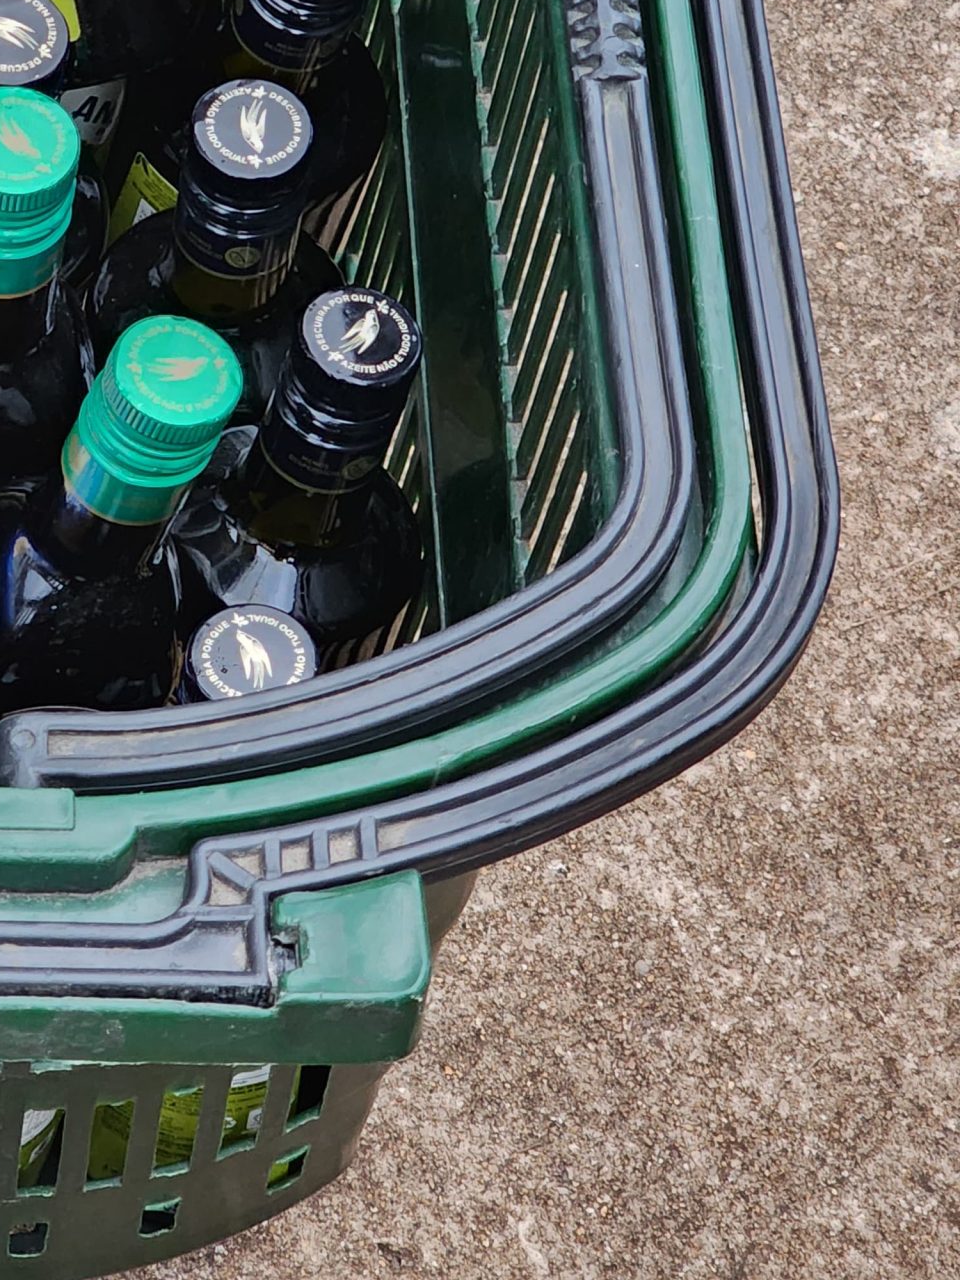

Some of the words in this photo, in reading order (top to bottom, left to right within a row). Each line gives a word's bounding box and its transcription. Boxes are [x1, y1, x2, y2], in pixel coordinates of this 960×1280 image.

[32, 0, 51, 17] NÃO
[45, 17, 57, 47] AZEITE
[218, 87, 252, 103] AZEITE
[206, 101, 222, 117] NÃO
[268, 91, 302, 134] DESCUBRA
[205, 125, 222, 149] TUDO
[284, 135, 301, 153] POR
[219, 146, 248, 165] IGUAL
[265, 151, 288, 165] QUE
[313, 305, 330, 351] DESCUBRA
[329, 294, 350, 307] POR
[351, 293, 375, 304] QUE
[389, 309, 409, 333] IGUAL
[400, 334, 411, 357] TUDO
[341, 360, 376, 374] AZEITE
[376, 359, 397, 372] NÃO
[210, 620, 230, 638] QUE
[246, 614, 280, 627] IGUAL
[278, 624, 301, 647] TUDO
[201, 638, 215, 659] POR
[294, 655, 306, 676] NÃO
[203, 661, 243, 697] SCUBRA
